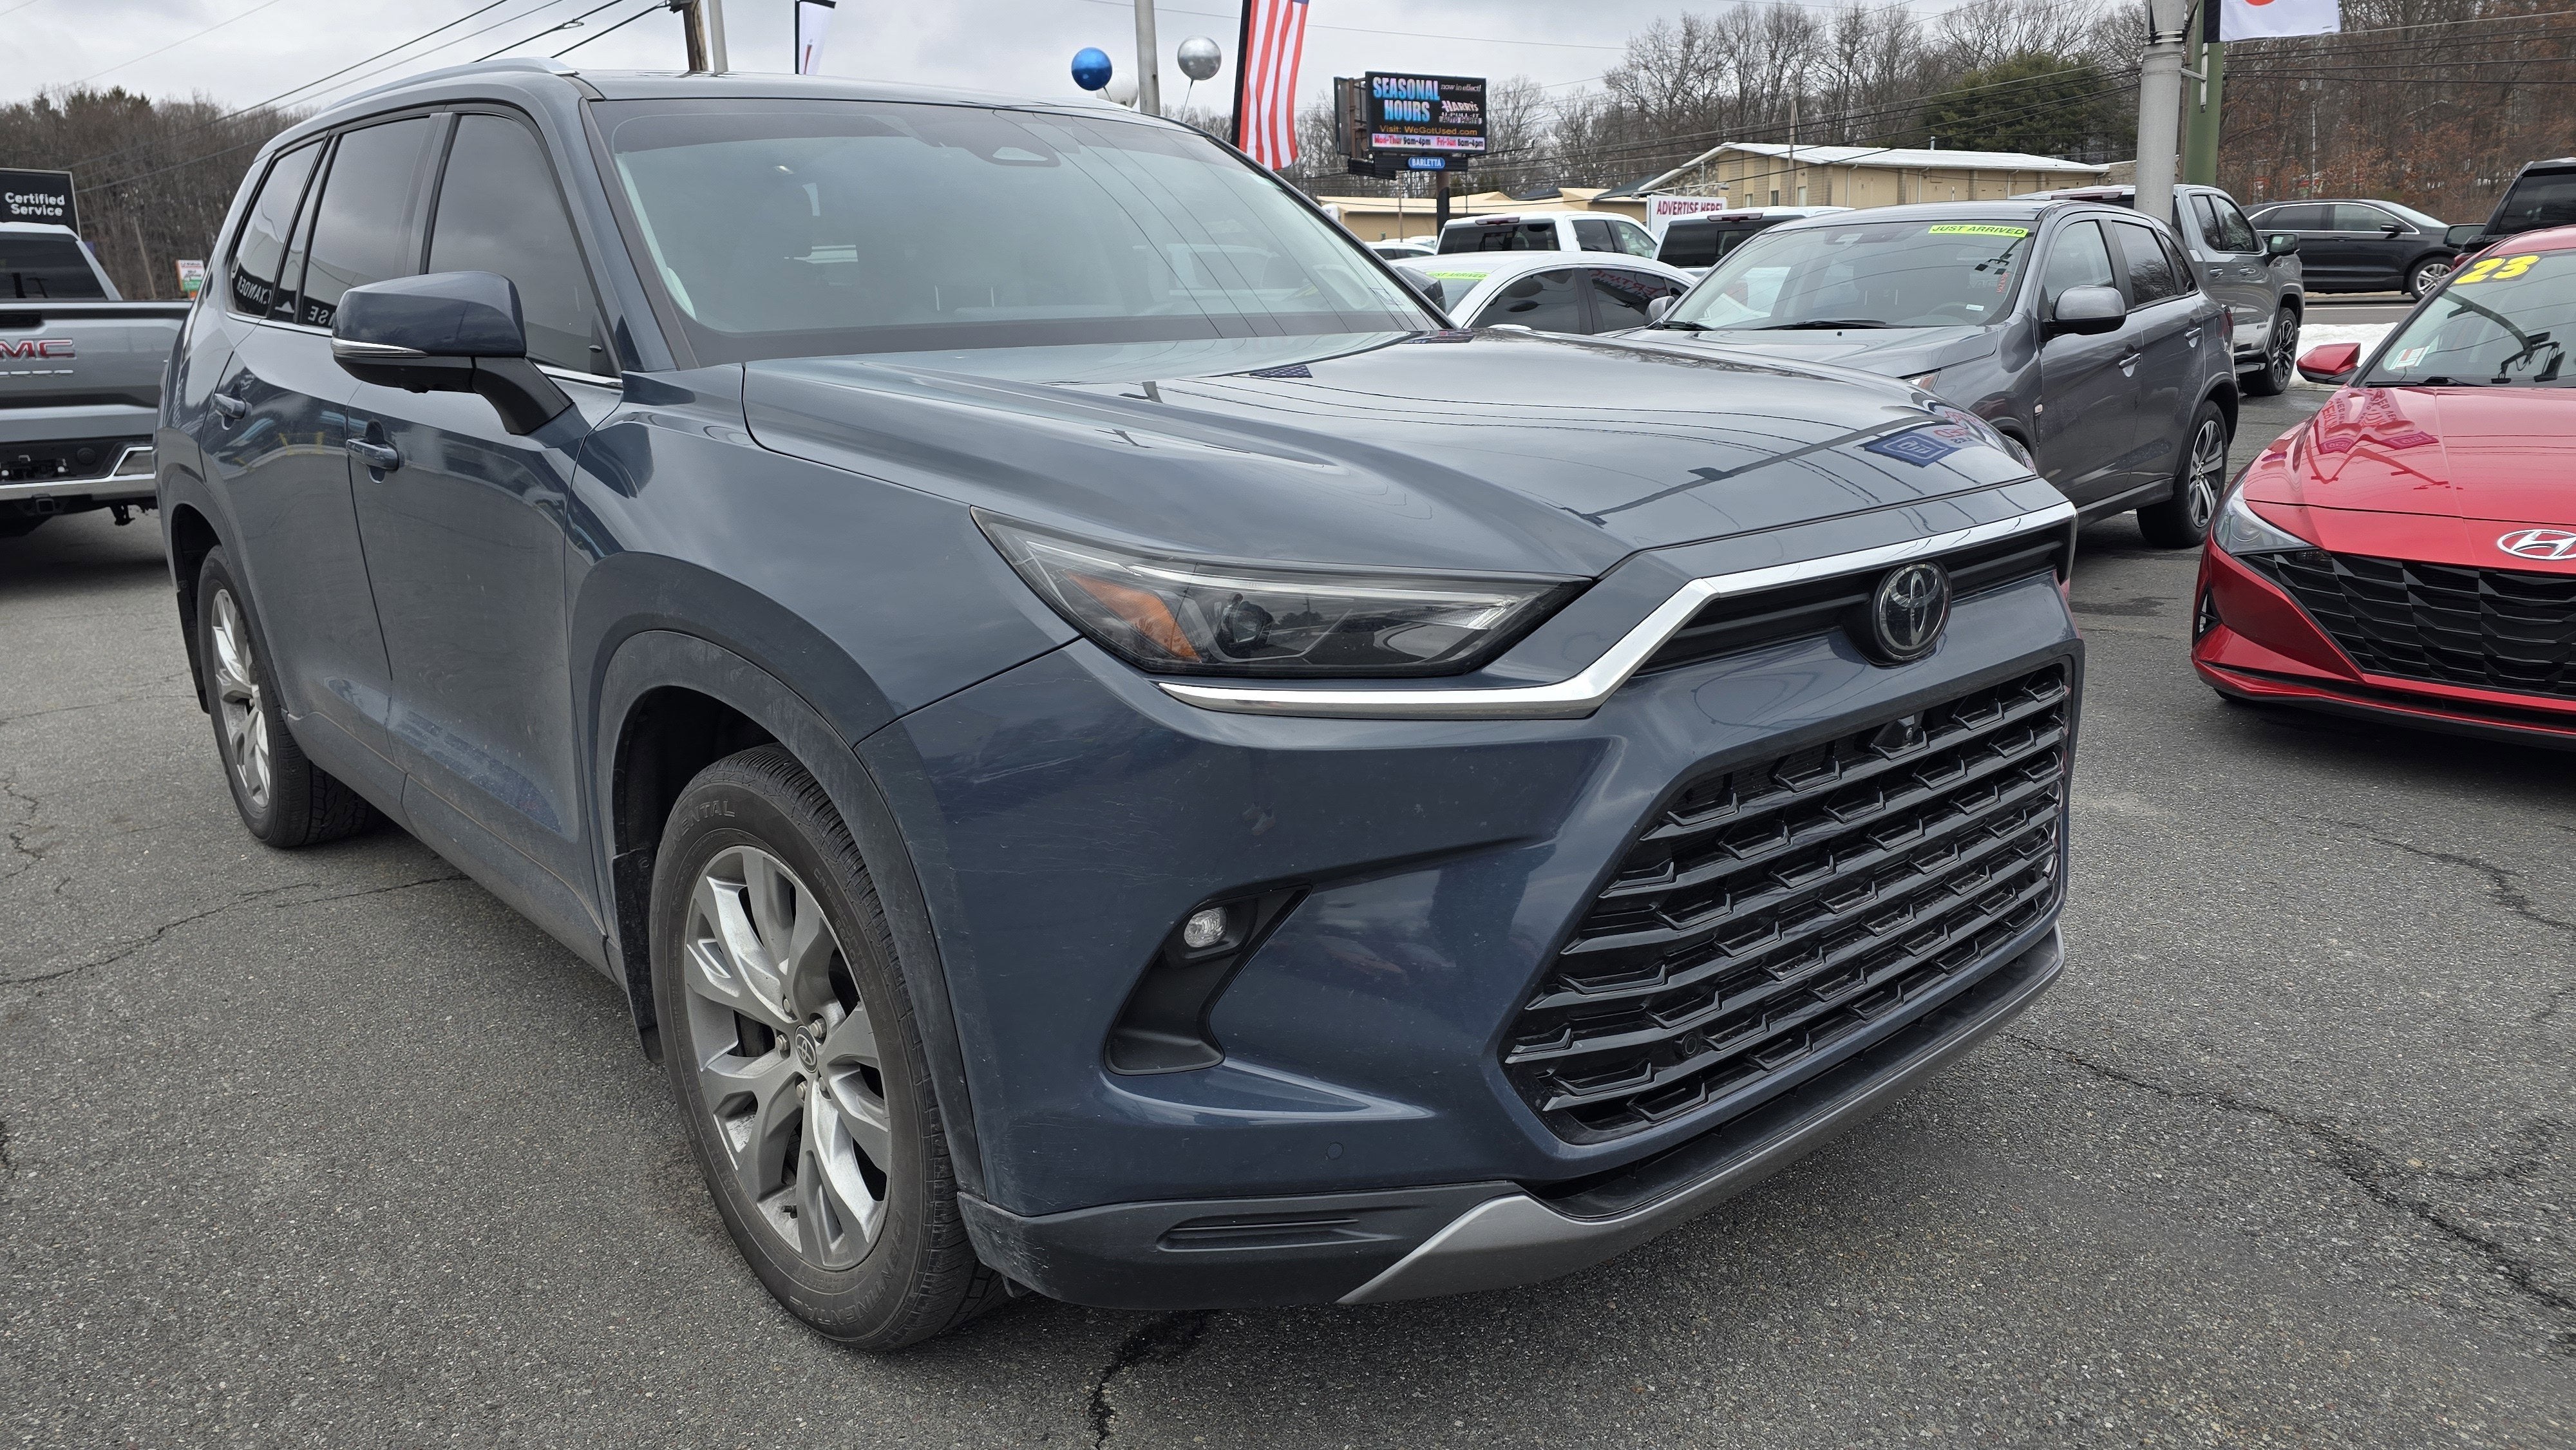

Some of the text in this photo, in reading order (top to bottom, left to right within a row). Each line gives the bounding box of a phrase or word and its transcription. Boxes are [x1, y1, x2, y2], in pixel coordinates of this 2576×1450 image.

[1373, 77, 1441, 100] SEASONAL
[1384, 99, 1430, 122] HOURS
[1412, 158, 1443, 167] BARLETTA
[5, 192, 65, 206] Certified
[11, 203, 63, 216] Service
[1656, 200, 1699, 216] ADVERTISE
[1967, 225, 2025, 235] ARRIVED
[2454, 255, 2541, 285] 23
[0, 339, 76, 359] MC
